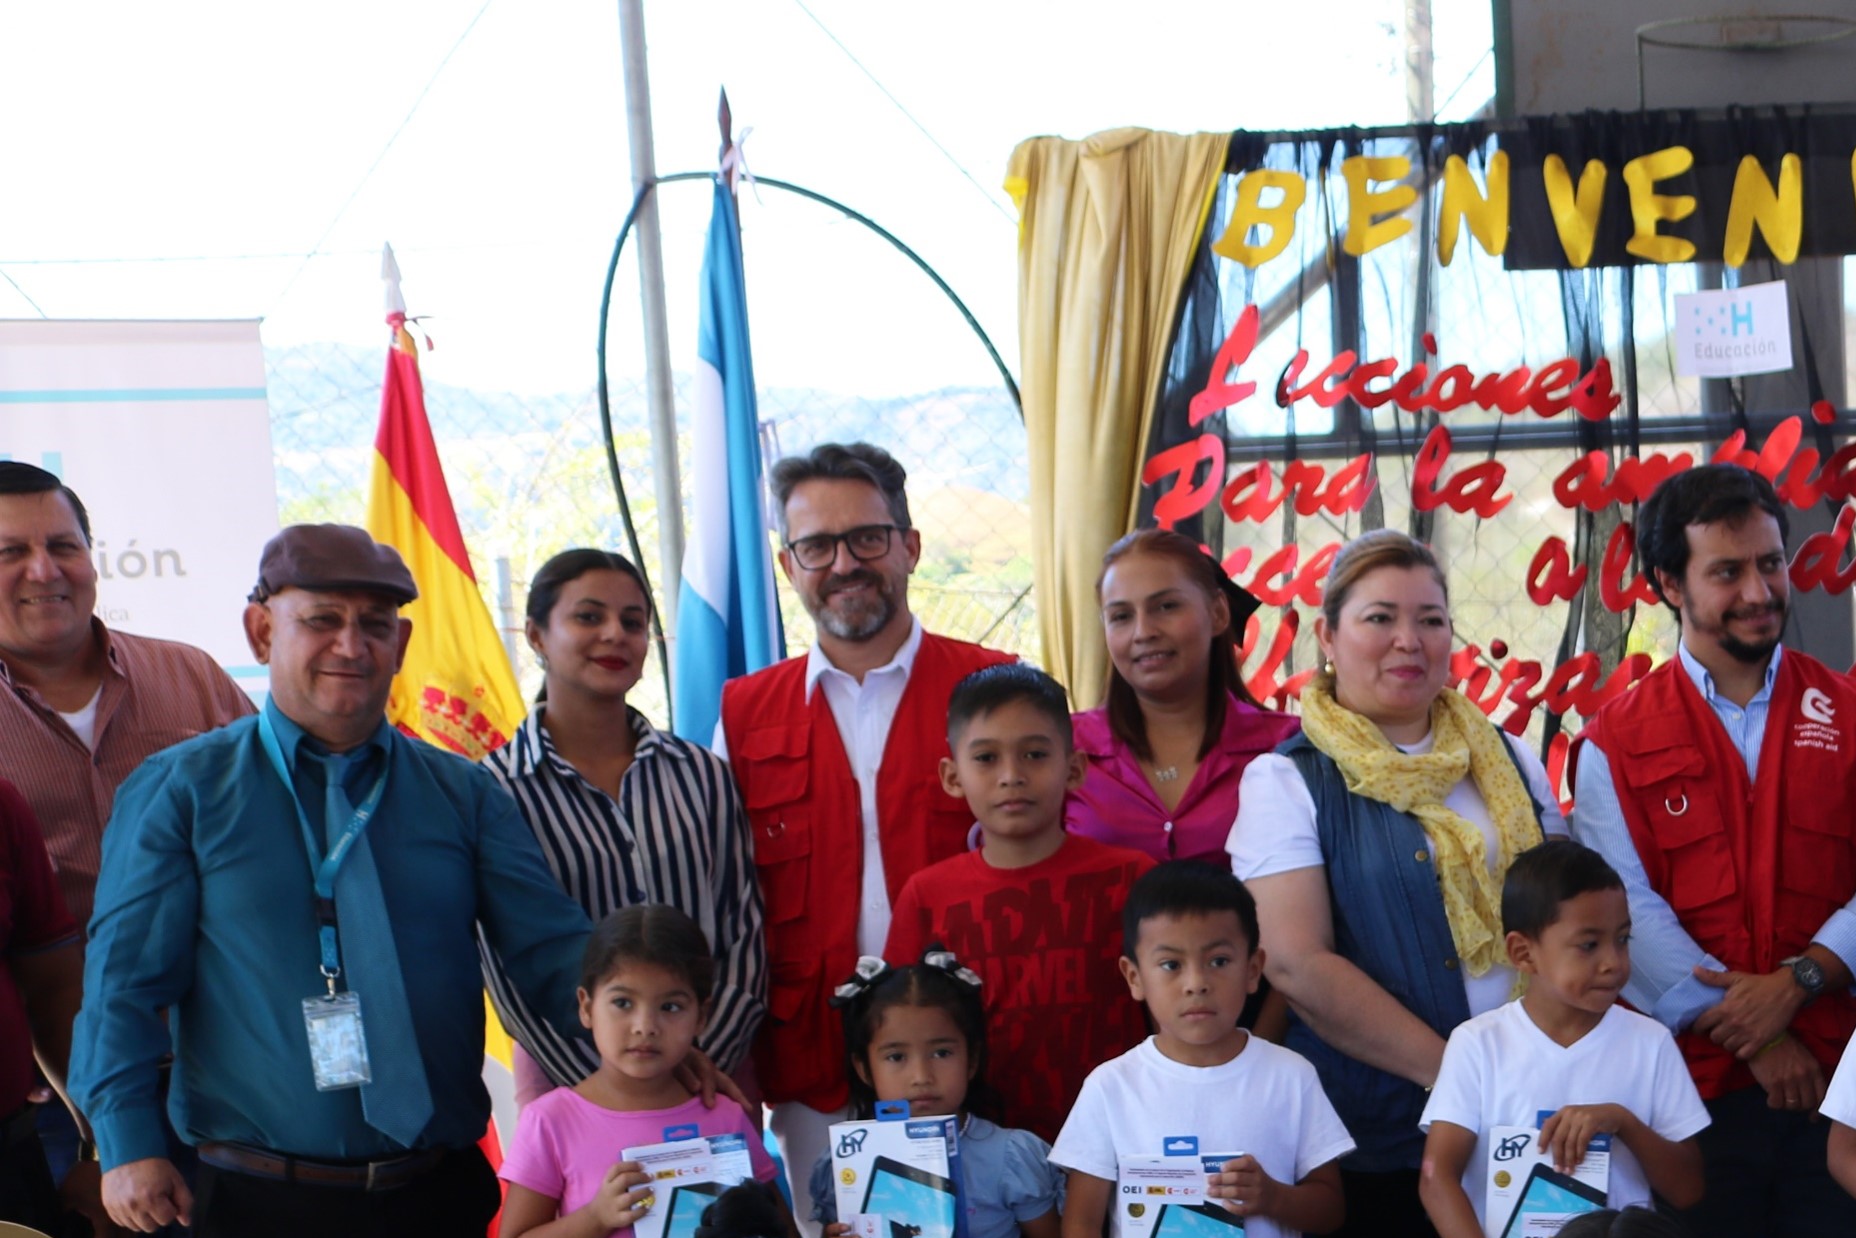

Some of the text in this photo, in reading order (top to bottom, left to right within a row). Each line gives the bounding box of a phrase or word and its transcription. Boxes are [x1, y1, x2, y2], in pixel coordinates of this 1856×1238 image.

[1694, 338, 1777, 359] Educación
[1142, 433, 1378, 531] Para
[1411, 425, 1513, 519] la
[1526, 536, 1588, 606] a
[1794, 723, 1840, 736] cooperación
[1800, 730, 1834, 741] española
[1794, 739, 1838, 752] spanish aid
[1123, 1185, 1142, 1194] OEI
